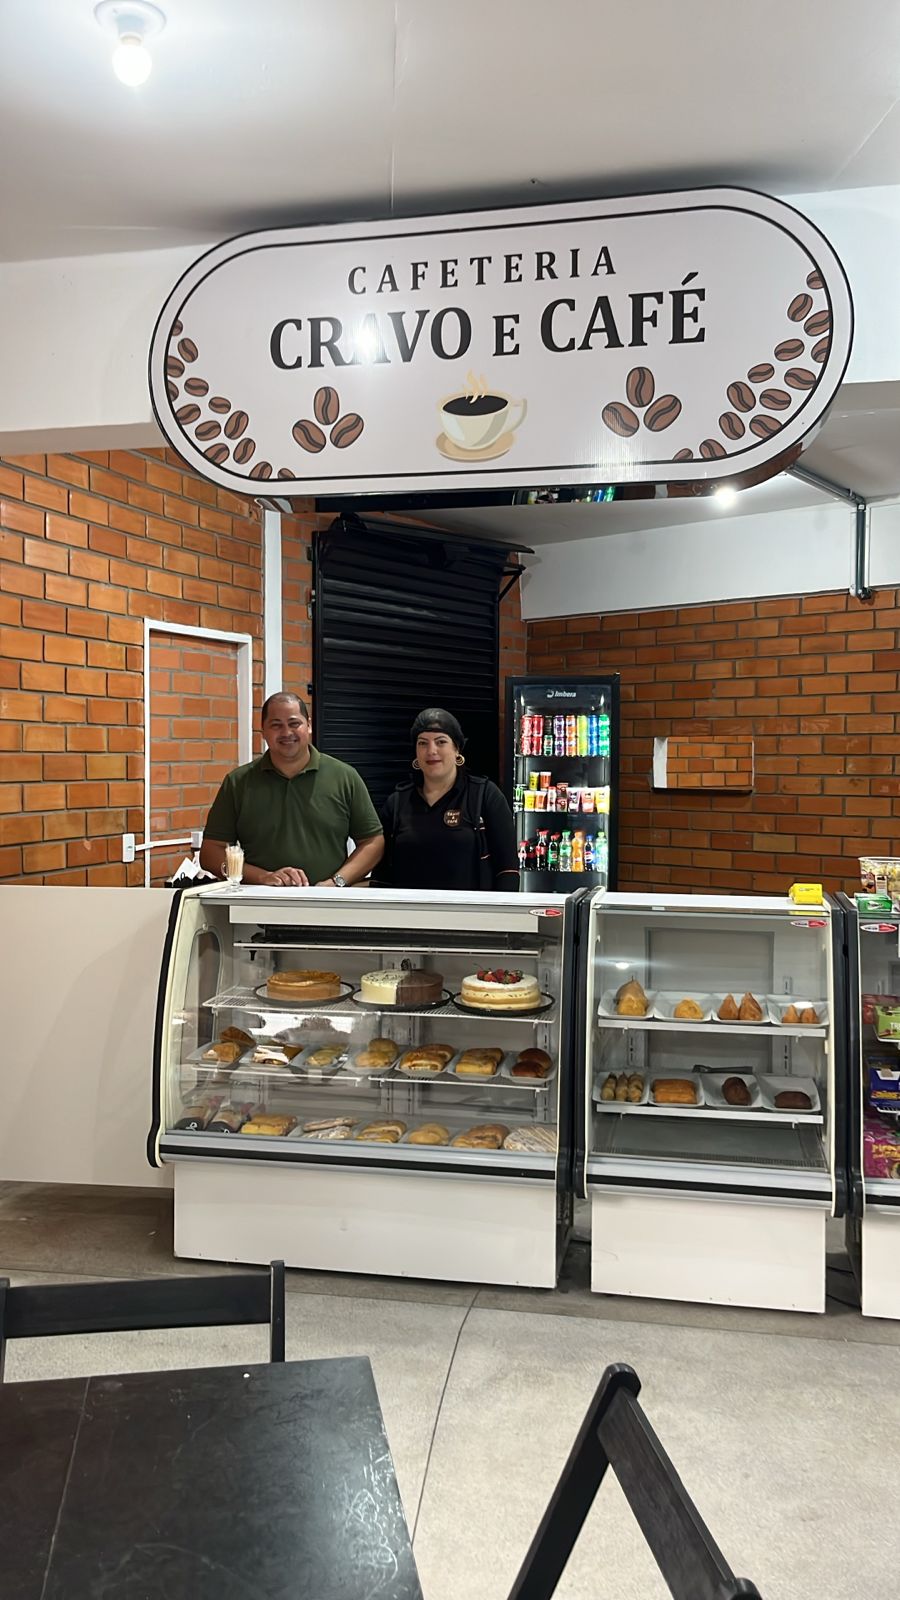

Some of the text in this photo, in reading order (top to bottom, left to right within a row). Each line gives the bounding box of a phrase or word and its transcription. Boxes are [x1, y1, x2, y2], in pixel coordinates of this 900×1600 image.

[348, 245, 616, 295] CAFETERIA
[269, 271, 706, 371] CRAVO E CAFÉ
